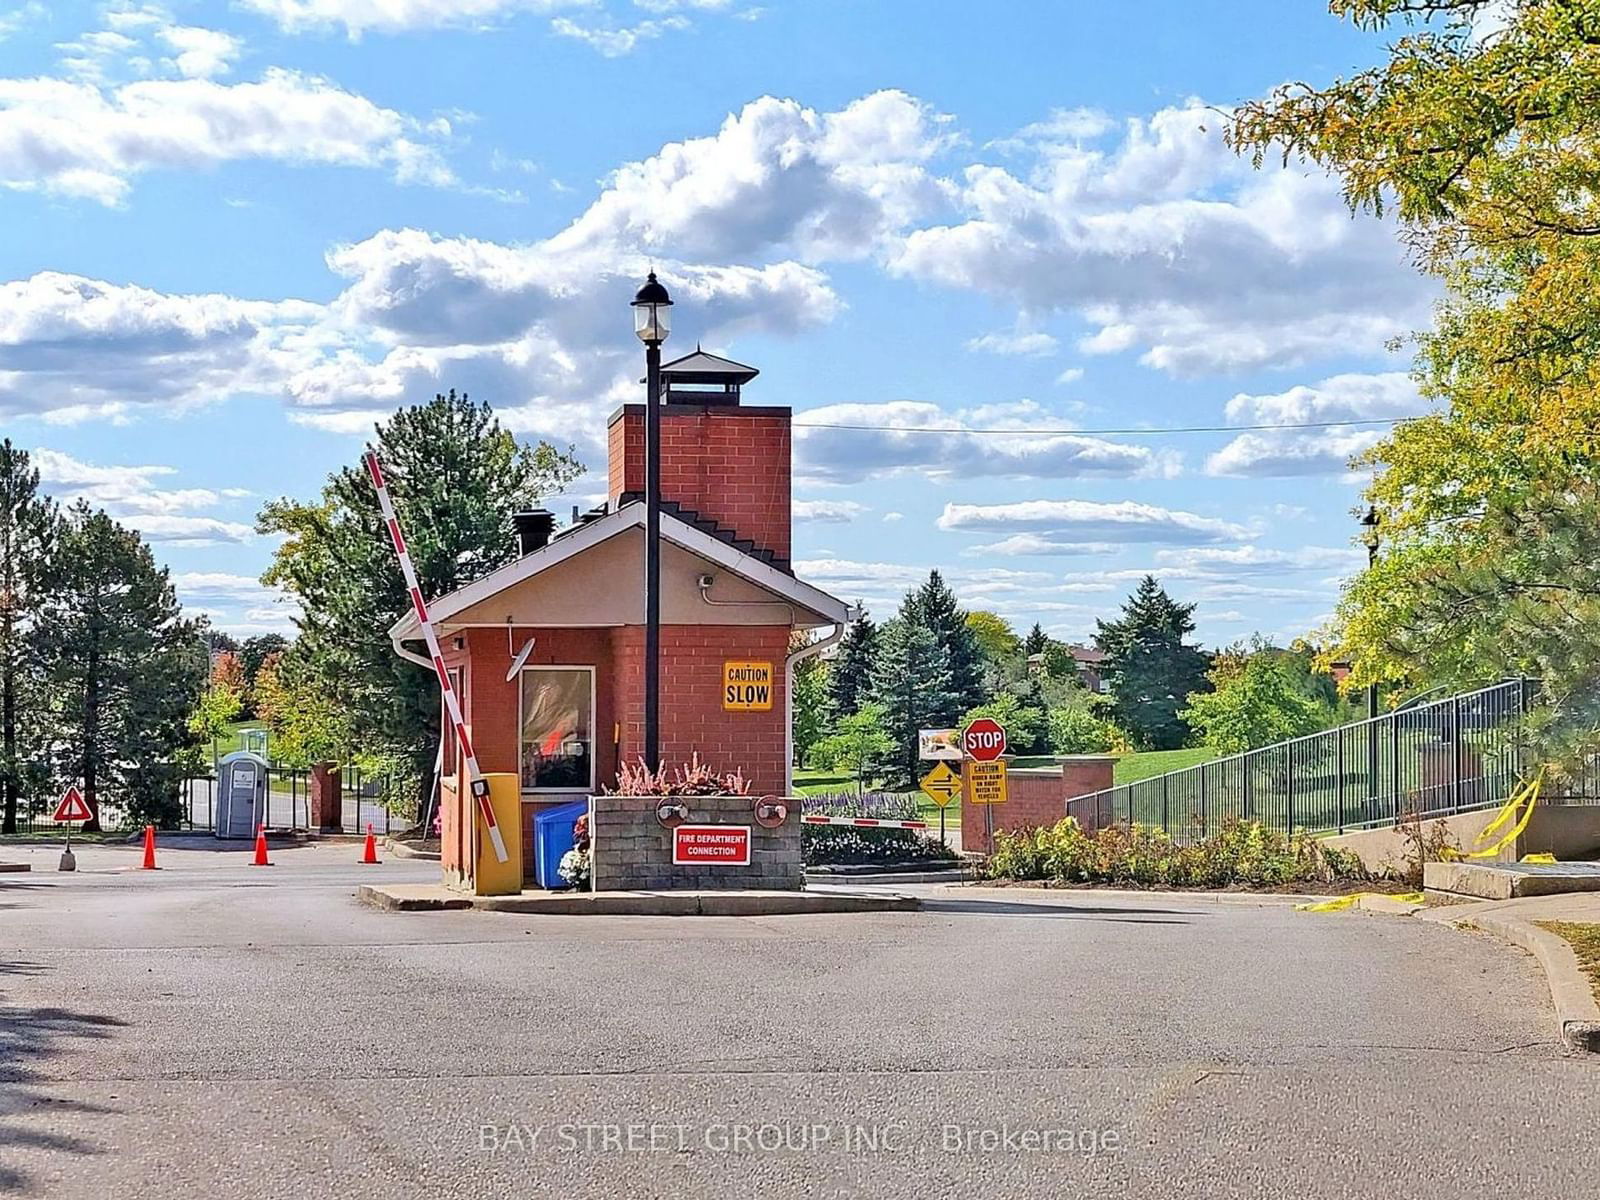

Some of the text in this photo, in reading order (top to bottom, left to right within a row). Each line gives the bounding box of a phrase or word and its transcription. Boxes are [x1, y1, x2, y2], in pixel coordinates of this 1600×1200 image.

[728, 668, 768, 681] CAUTION
[726, 685, 769, 703] SLOW
[968, 732, 1002, 749] STOP
[974, 765, 999, 773] CAUTION
[679, 834, 746, 844] FIRE DEPARTMENT
[687, 846, 736, 856] CONNECTION
